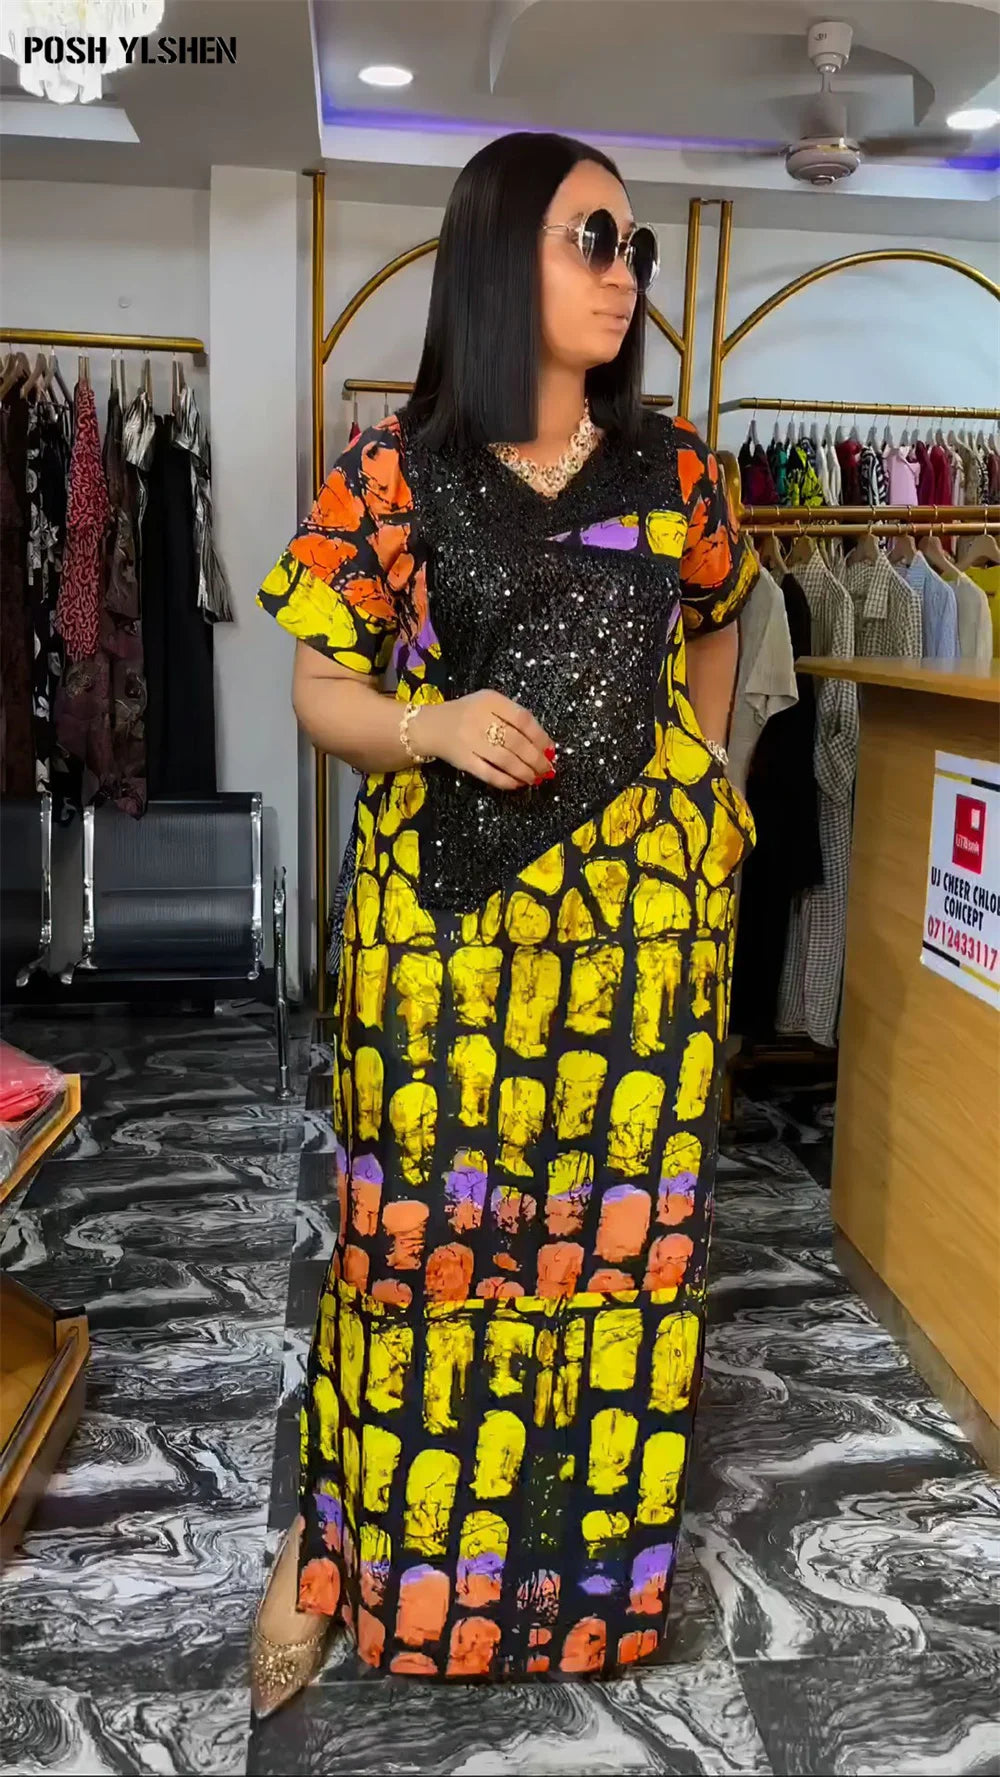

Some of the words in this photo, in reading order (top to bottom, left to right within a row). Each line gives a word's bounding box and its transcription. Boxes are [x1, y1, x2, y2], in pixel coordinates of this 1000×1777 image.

[931, 866, 941, 887] UJ
[943, 872, 971, 902] CHEER
[944, 895, 984, 931] CONCEPT
[927, 914, 998, 971] 0712433117
